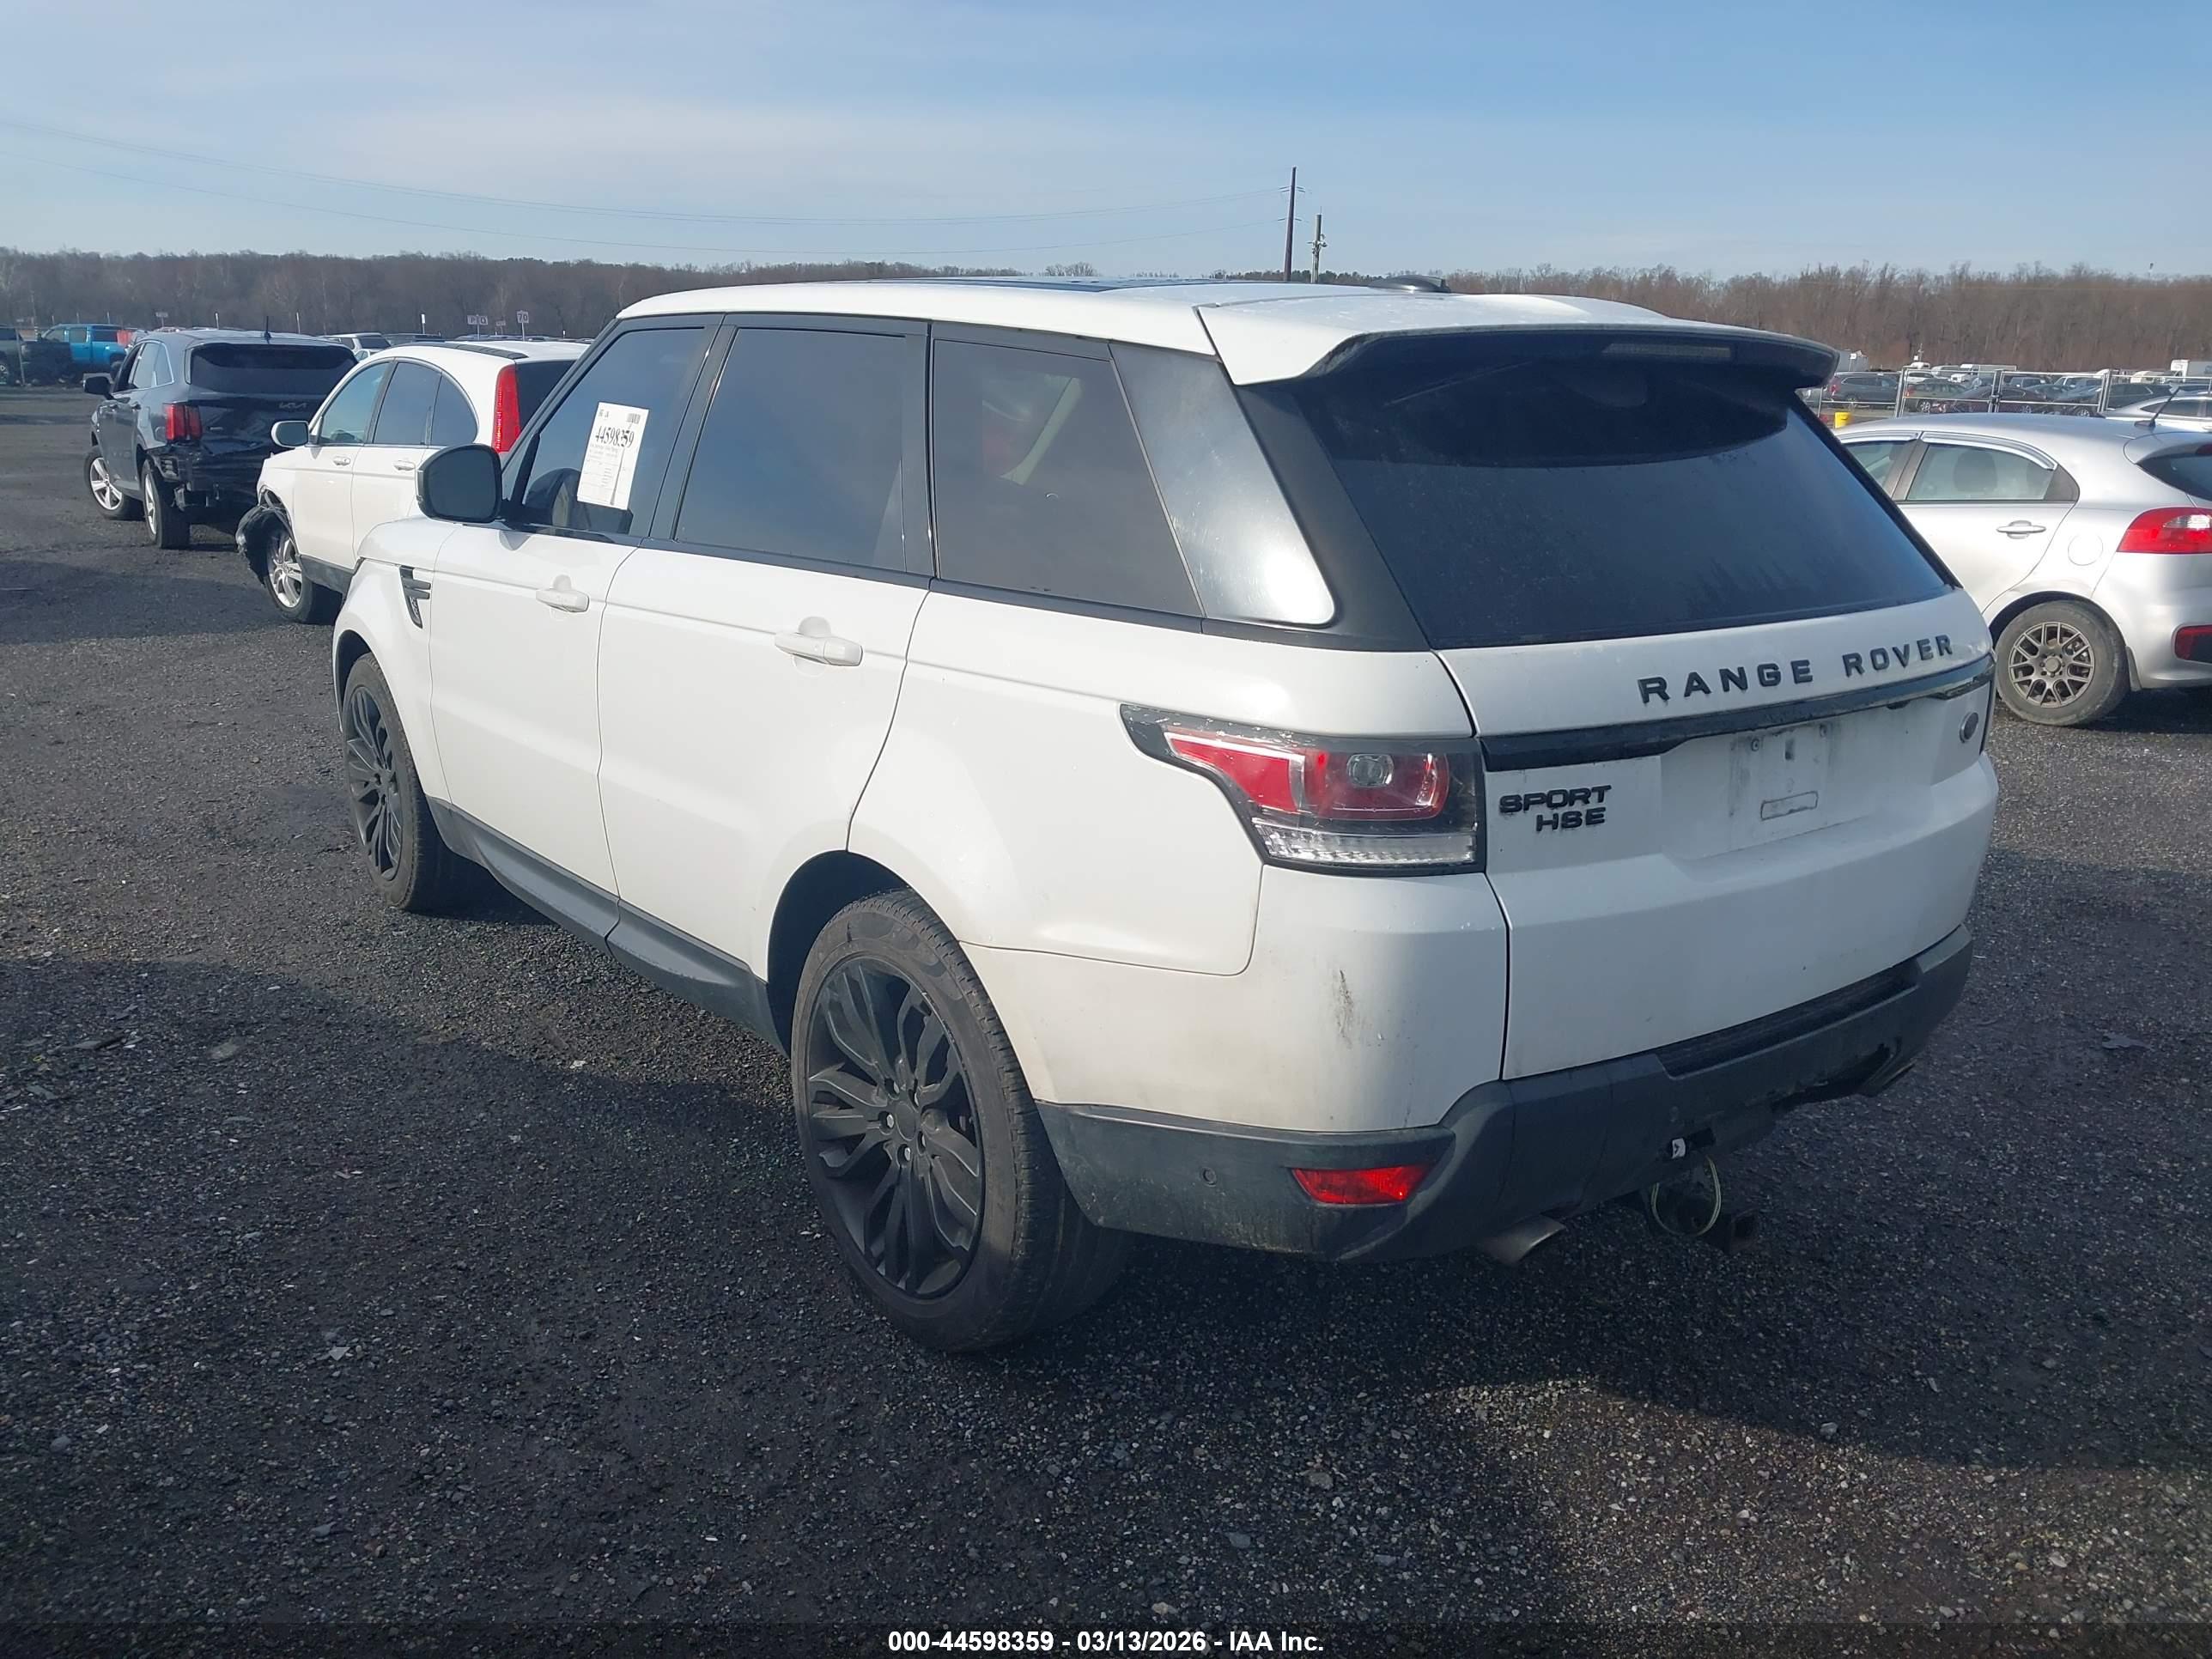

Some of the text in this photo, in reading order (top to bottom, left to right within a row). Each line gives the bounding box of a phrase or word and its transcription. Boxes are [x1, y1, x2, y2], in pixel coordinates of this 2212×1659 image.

[595, 426, 635, 448] 44598359
[1638, 634, 1954, 703] RANGE ROVER
[1499, 785, 1612, 813] SPORT
[1536, 807, 1606, 832] HSE
